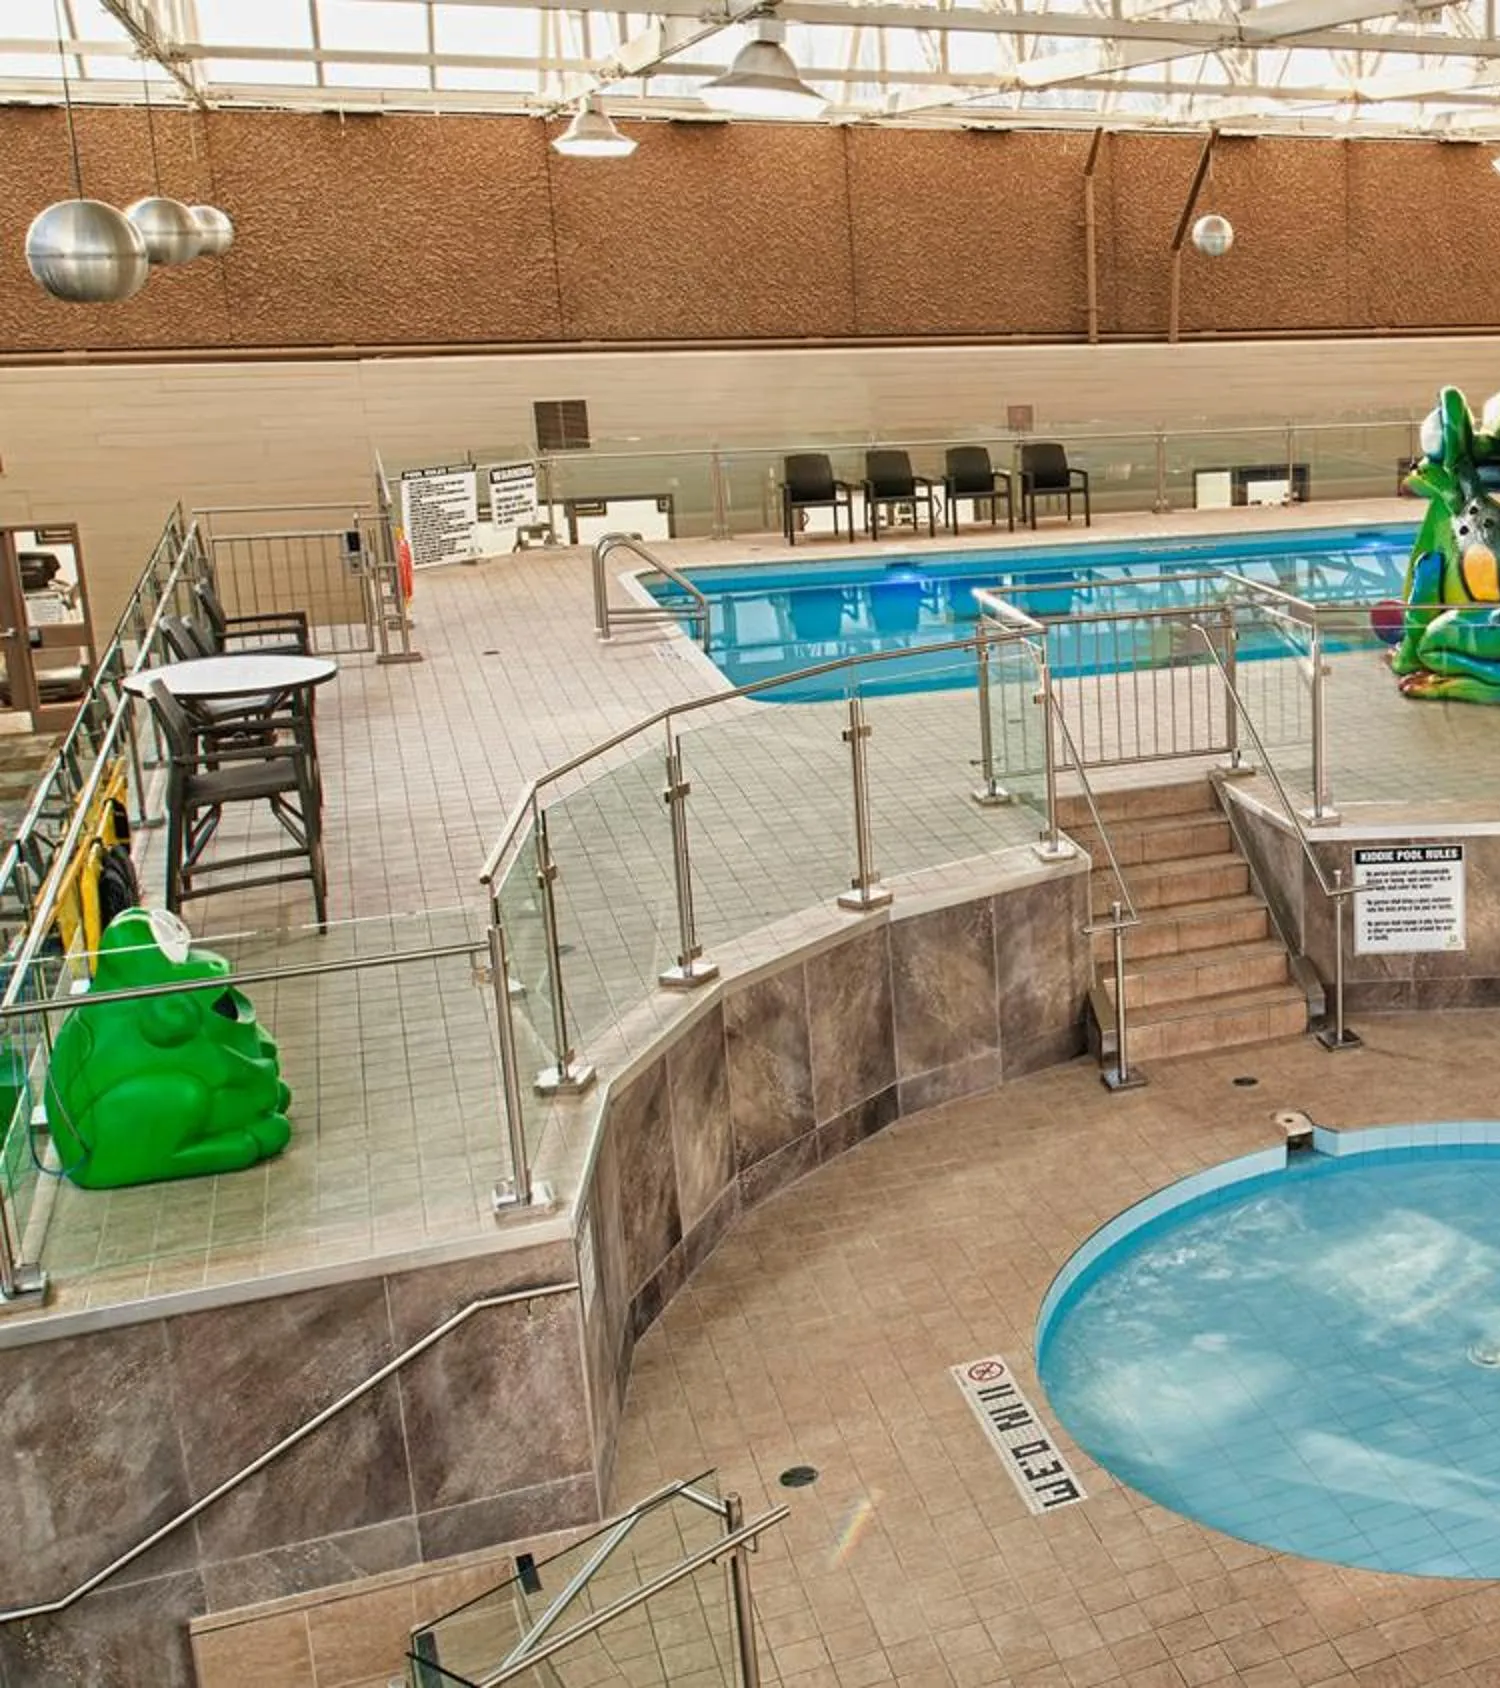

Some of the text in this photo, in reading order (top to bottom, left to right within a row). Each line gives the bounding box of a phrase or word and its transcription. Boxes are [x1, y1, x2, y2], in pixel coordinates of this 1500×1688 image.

[493, 466, 533, 481] WARNING
[1360, 848, 1458, 862] KIDDIE POOL RULES
